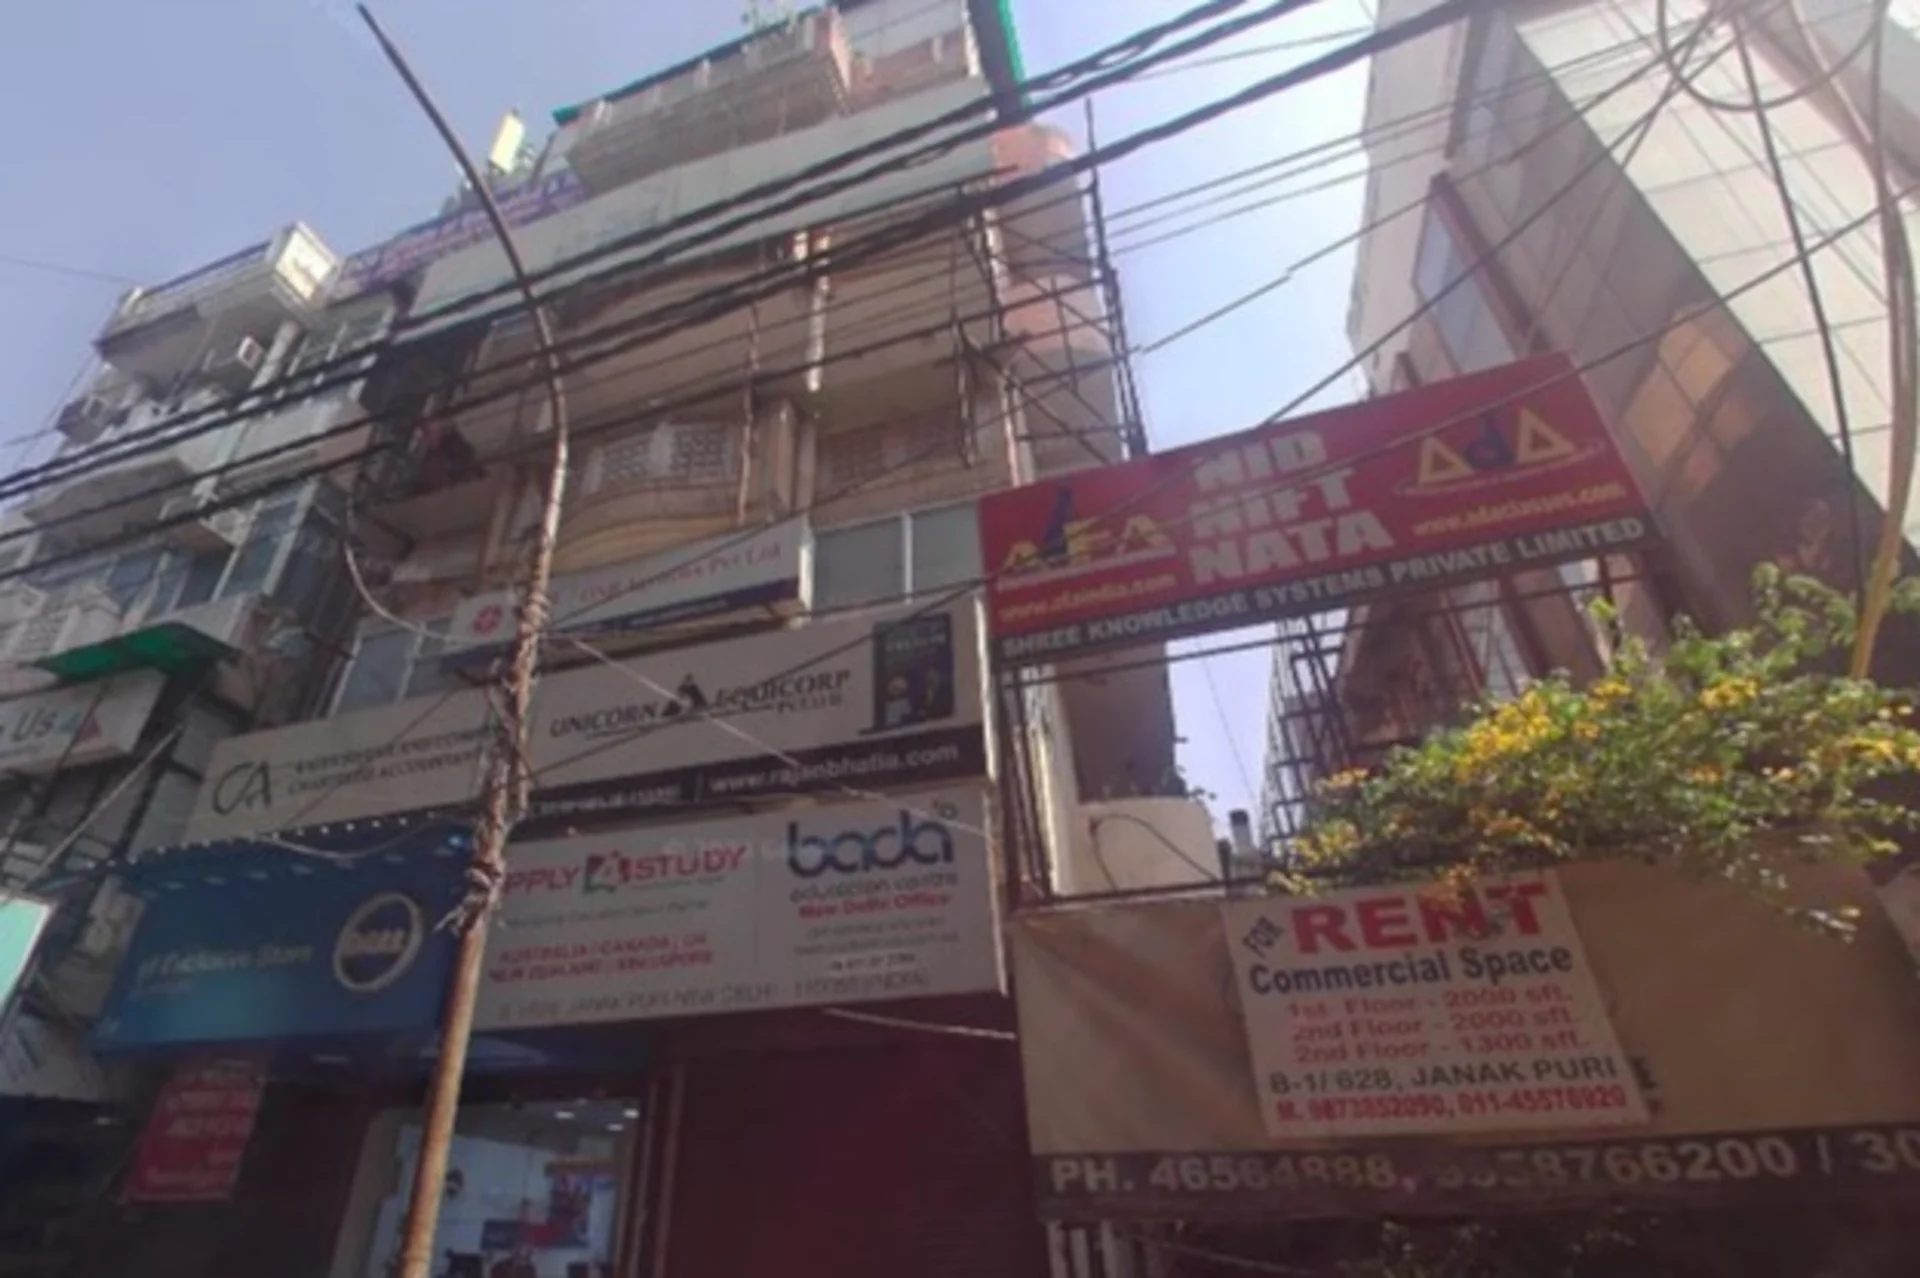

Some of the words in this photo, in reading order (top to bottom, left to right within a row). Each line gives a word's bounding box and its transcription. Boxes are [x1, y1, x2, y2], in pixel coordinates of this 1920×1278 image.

[1193, 431, 1327, 491] NID
[1189, 510, 1396, 583] NATA
[1002, 624, 1082, 657] SHREE
[1087, 591, 1250, 641] KNOWLEDGE
[1255, 564, 1386, 608] SYSTEMS
[1390, 541, 1512, 582] PRIVATE
[1514, 516, 1646, 559] LIMITED
[549, 699, 660, 738] UNICORN
[630, 845, 748, 882] STUDY
[1292, 881, 1548, 954] RENT
[1250, 950, 1452, 995] Commercial
[1459, 945, 1574, 986] Space
[1349, 1018, 1423, 1039] Floor
[1356, 1041, 1430, 1061] Floor
[1411, 1059, 1527, 1088] JANAK
[1531, 1055, 1618, 1082] PURI
[1050, 1155, 1135, 1194] PH.
